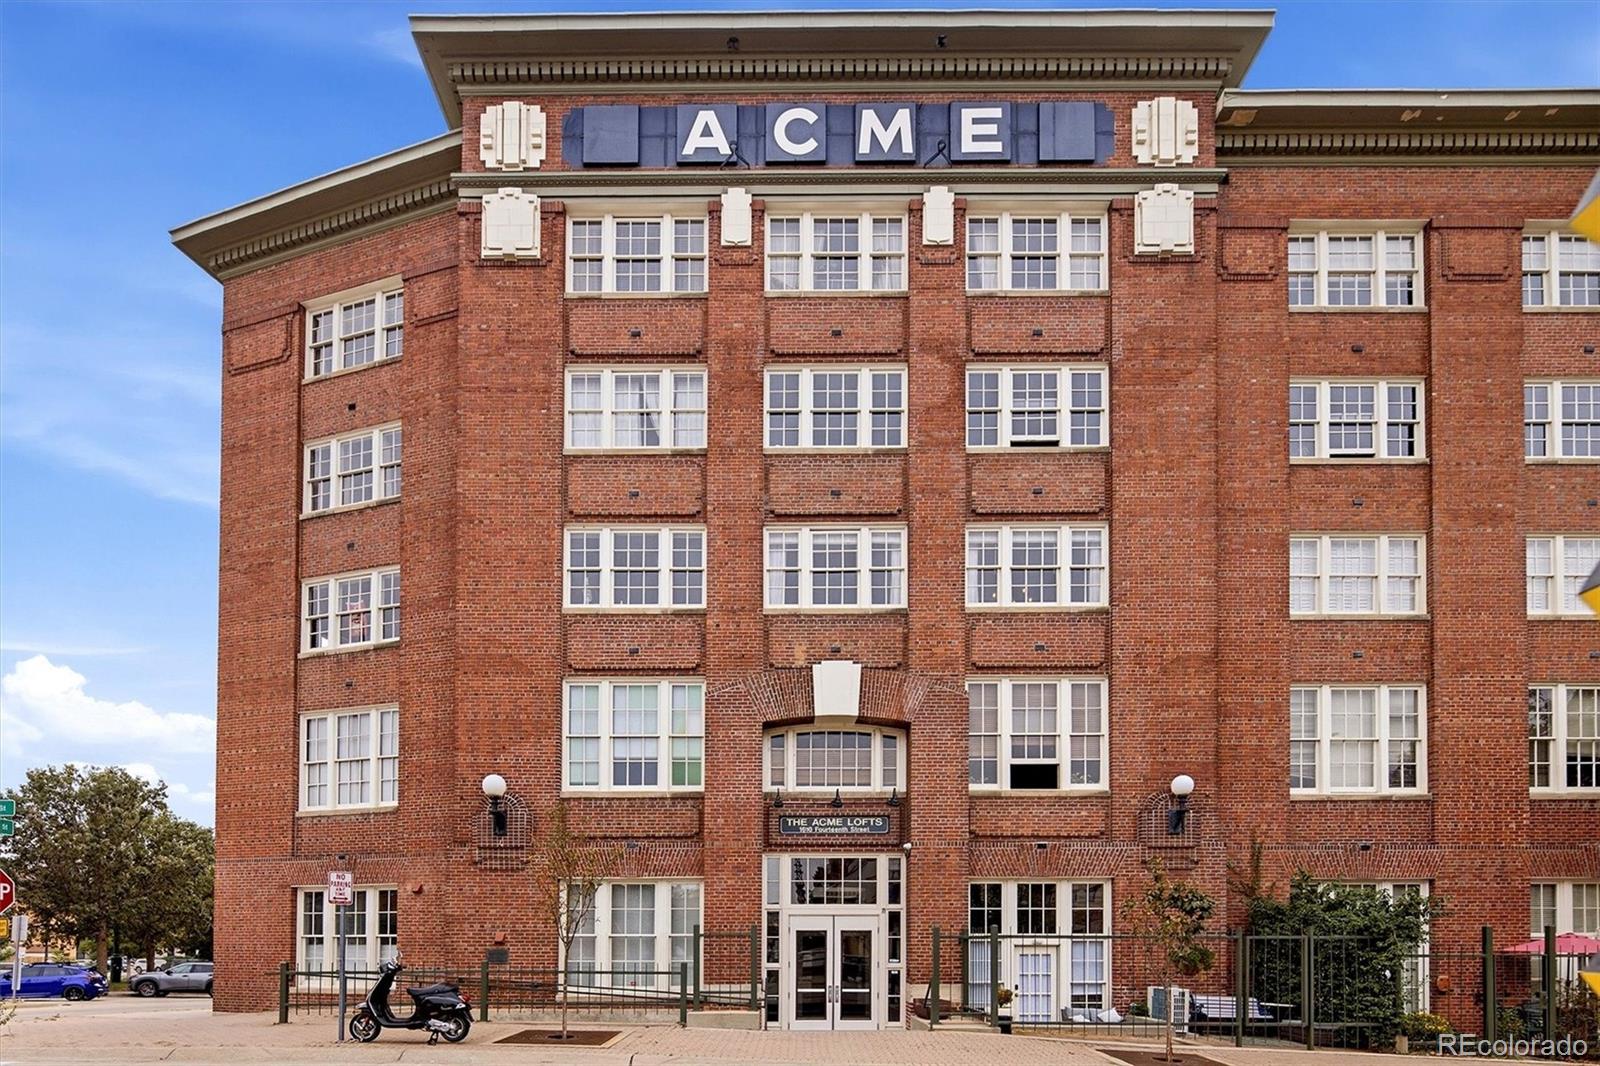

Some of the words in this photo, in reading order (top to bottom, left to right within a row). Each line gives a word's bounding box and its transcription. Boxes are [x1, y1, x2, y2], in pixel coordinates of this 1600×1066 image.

[681, 107, 1003, 155] ACME
[786, 818, 808, 826] THE
[811, 818, 843, 826] ACME
[847, 818, 883, 826] LOFTS
